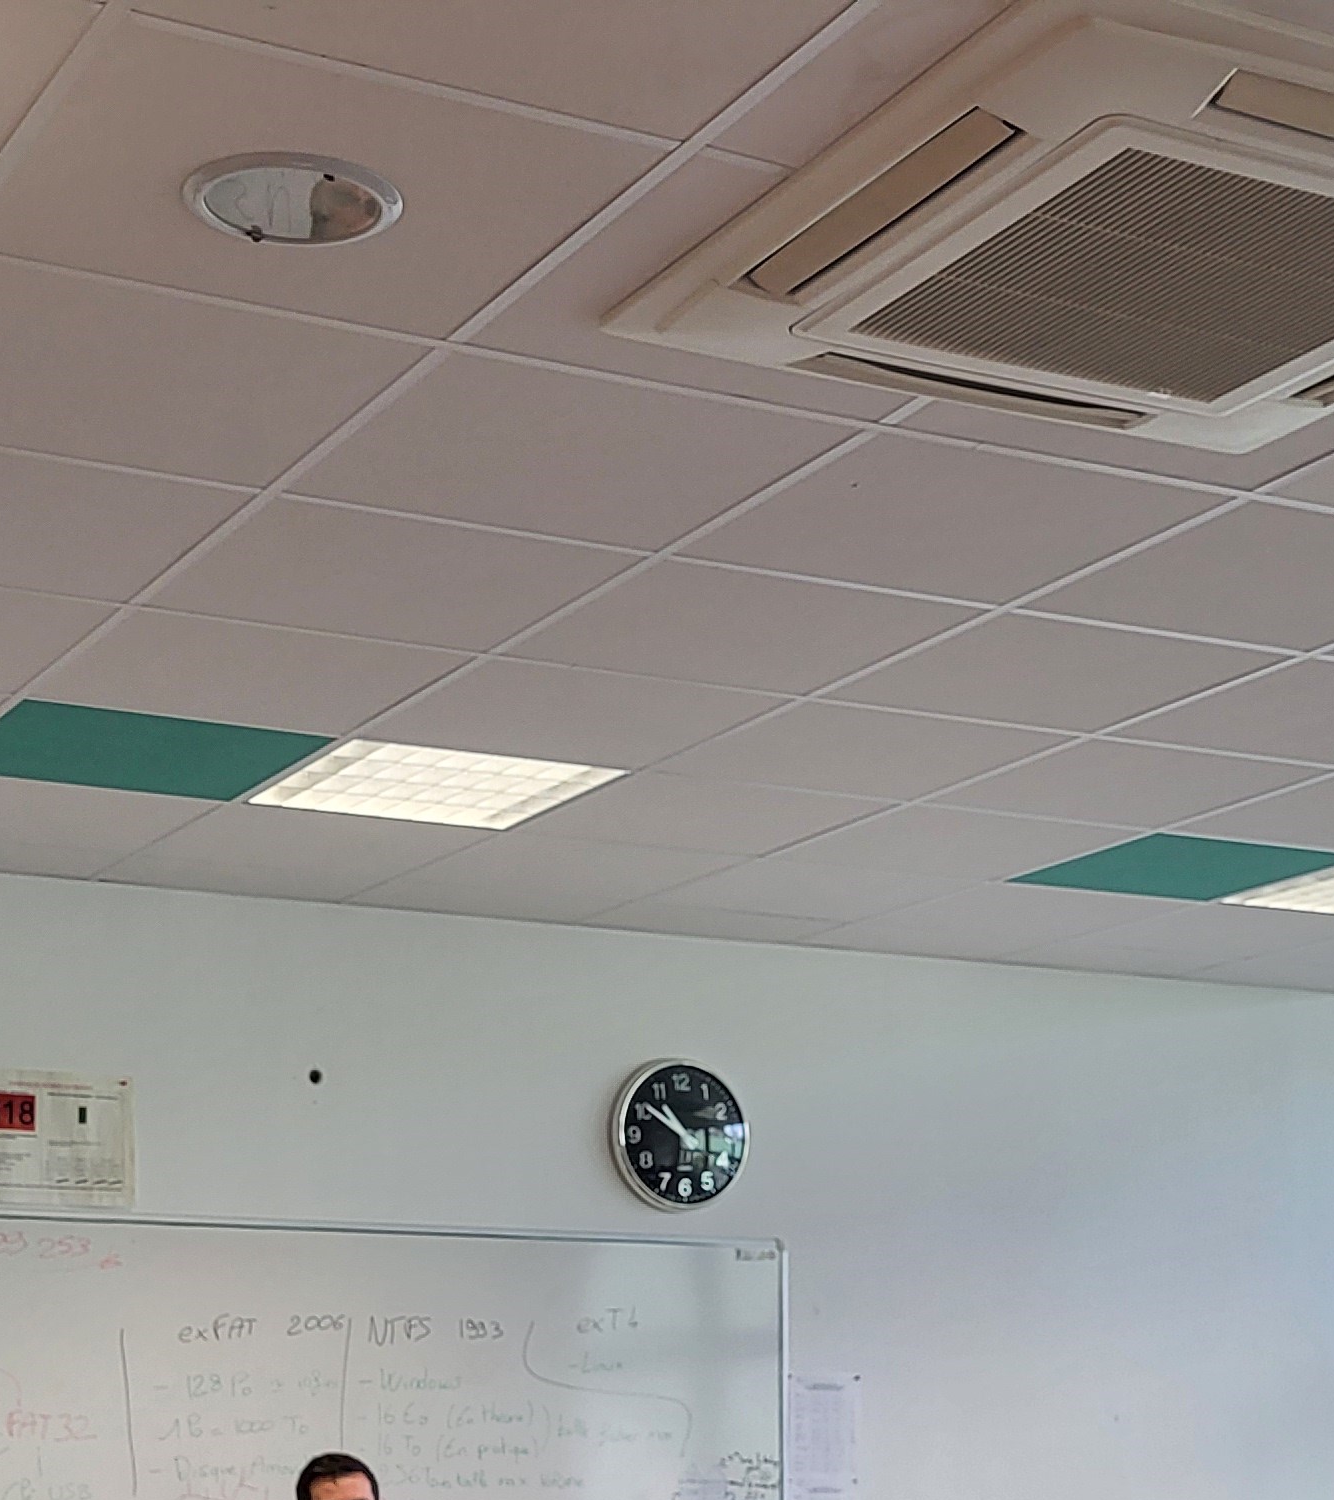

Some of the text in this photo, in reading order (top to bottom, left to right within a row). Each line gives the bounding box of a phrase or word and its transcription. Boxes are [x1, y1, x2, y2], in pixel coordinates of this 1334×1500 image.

[652, 1082, 668, 1101] 11
[672, 1072, 691, 1092] 12
[701, 1083, 710, 1101] 1
[715, 1103, 727, 1121] 2
[627, 1125, 642, 1145] 9
[639, 1150, 654, 1169] 8
[716, 1150, 730, 1169] 4
[658, 1172, 672, 1191] 7
[678, 1178, 693, 1197] 6
[700, 1171, 715, 1191] 5
[177, 1312, 345, 1344] exFAT 2006
[458, 1320, 505, 1340] 1993
